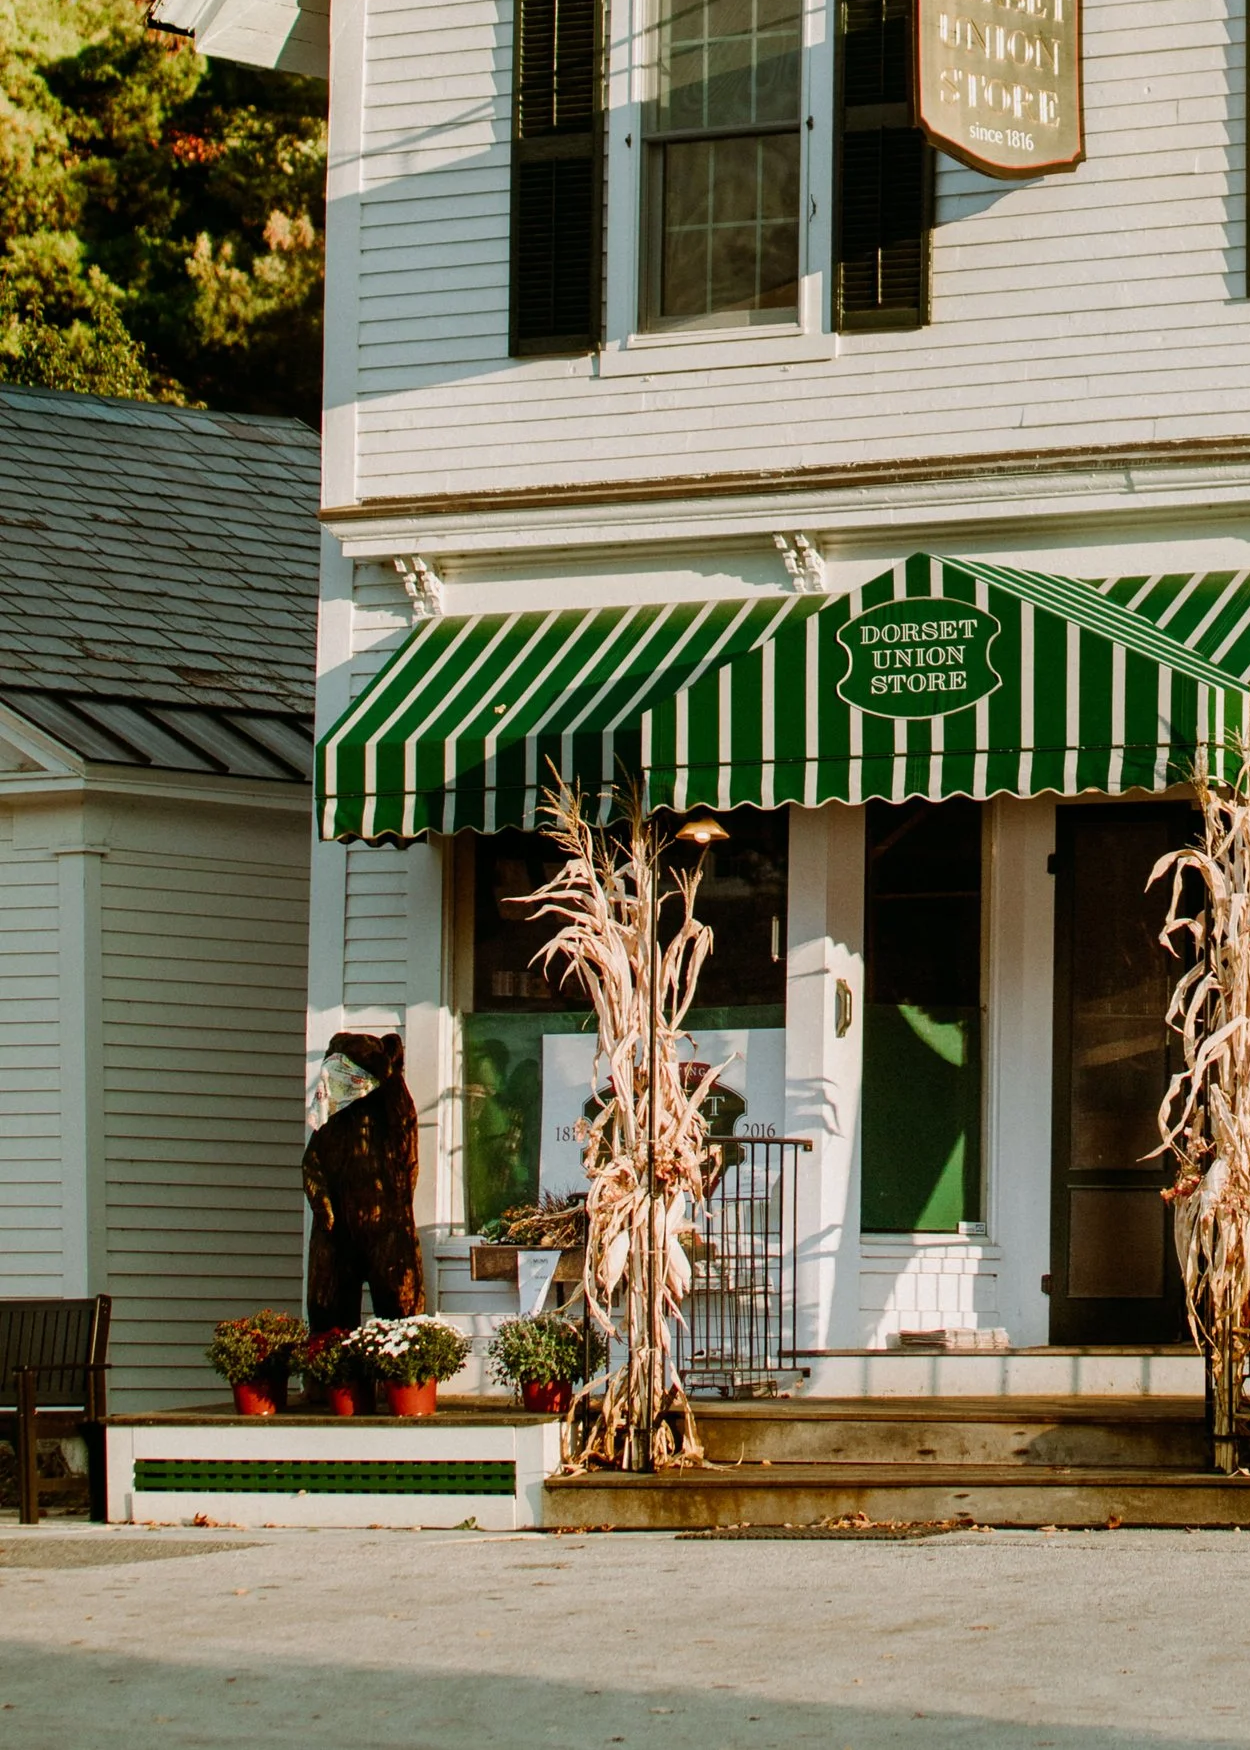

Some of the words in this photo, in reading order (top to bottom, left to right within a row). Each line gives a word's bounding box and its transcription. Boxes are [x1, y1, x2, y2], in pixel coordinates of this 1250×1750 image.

[939, 13, 1061, 76] UNION
[940, 66, 1061, 127] STORE
[969, 122, 1004, 144] since
[1005, 129, 1035, 151] 1816
[860, 619, 978, 645] DORSET
[871, 645, 966, 669] UNION
[870, 671, 967, 695] STORE
[556, 1126, 577, 1142] 181
[742, 1122, 776, 1138] 2016
